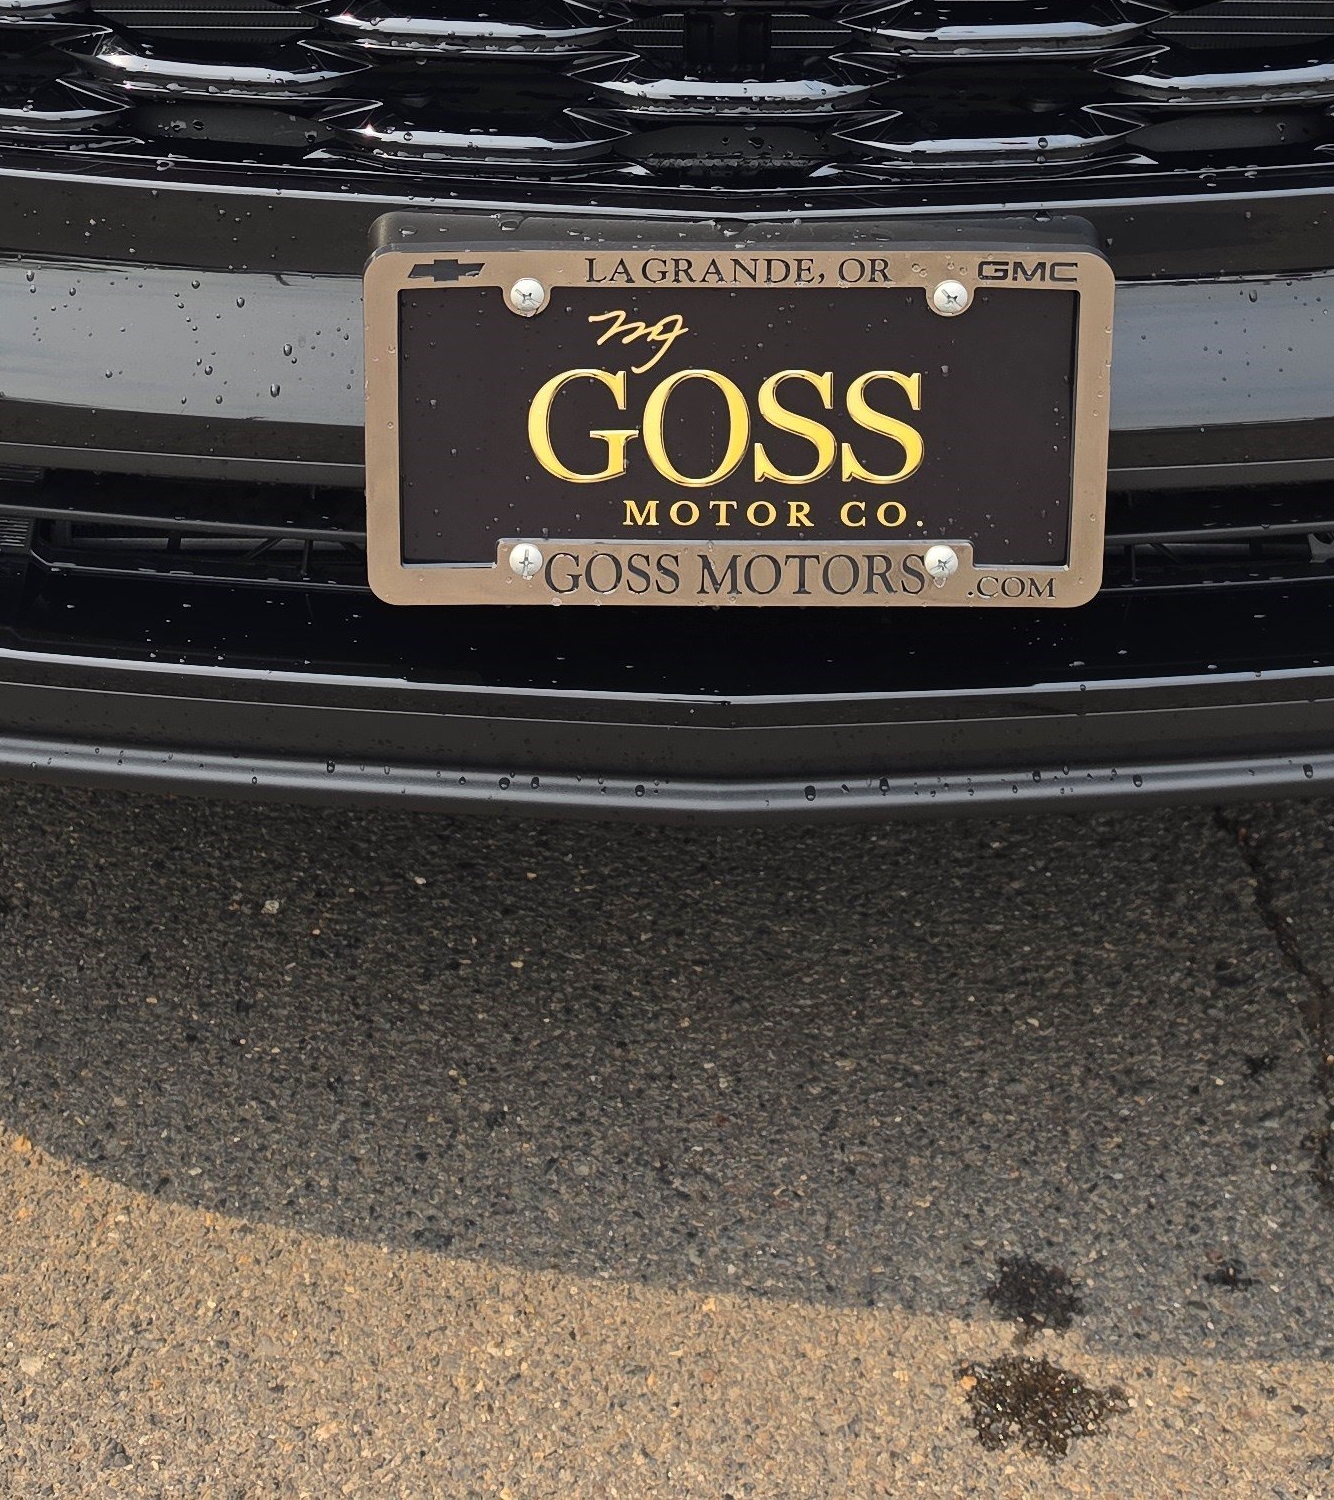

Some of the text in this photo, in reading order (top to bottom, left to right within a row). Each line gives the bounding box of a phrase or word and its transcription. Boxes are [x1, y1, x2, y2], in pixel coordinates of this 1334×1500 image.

[838, 257, 894, 285] OR
[977, 260, 1079, 283] GMC
[527, 367, 925, 488] GOSS
[622, 499, 925, 528] MOTOR CO.
[543, 551, 1057, 599] GOSS MOTORS .COM
